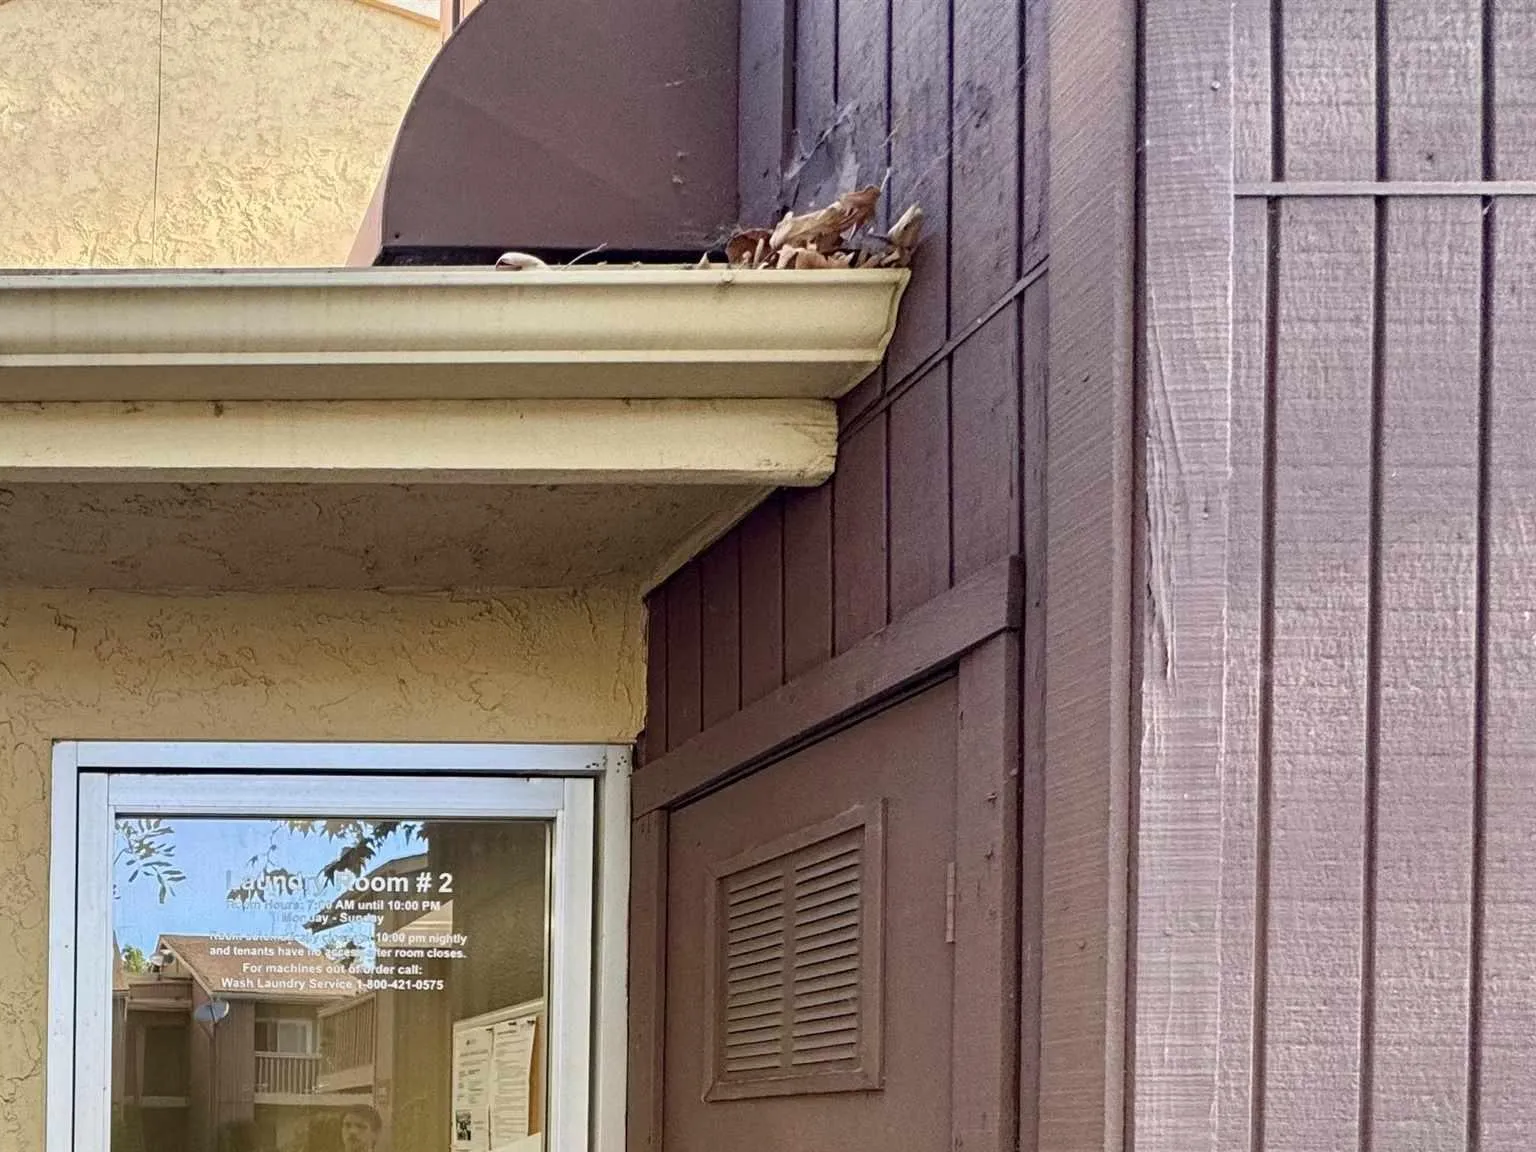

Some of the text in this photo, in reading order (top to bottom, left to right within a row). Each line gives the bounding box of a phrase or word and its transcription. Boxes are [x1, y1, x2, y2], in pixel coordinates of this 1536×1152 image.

[416, 872, 432, 893] #
[438, 872, 453, 893] 2
[335, 900, 354, 910] AM
[358, 900, 383, 910] until
[388, 900, 418, 911] 10:00
[422, 901, 440, 911] PM
[376, 932, 406, 943] 10:00
[408, 935, 425, 944] pm
[429, 933, 467, 945] nightly
[210, 946, 230, 956] and
[233, 946, 275, 956] tenants
[278, 946, 305, 956] have
[395, 949, 424, 958] room
[427, 948, 467, 959] closes.
[243, 963, 262, 973] For
[266, 963, 323, 974] machines
[326, 965, 345, 974] out
[397, 965, 423, 975] call:
[221, 978, 444, 991] Wash Laundry Service 1-800-421-0575
